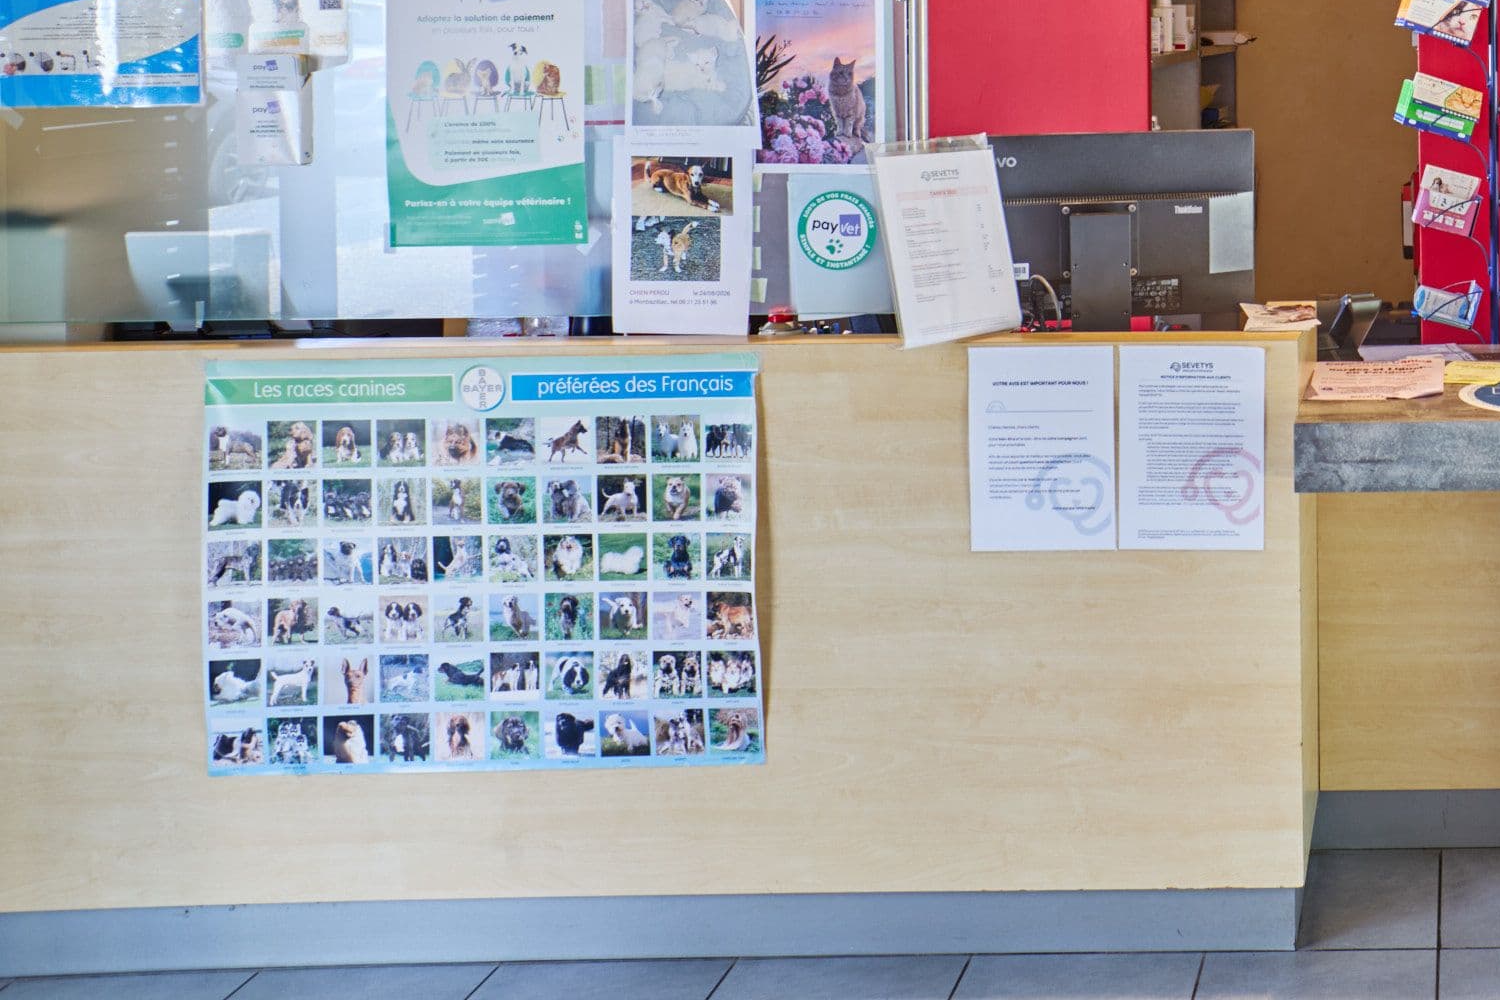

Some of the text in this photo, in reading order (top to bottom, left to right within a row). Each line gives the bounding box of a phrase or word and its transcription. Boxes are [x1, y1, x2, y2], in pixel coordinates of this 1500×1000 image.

[417, 14, 554, 24] Adoptez la solution de paiement
[516, 198, 566, 206] vétérinaire
[812, 220, 838, 234] pay
[254, 380, 406, 398] Les races canines
[463, 384, 503, 392] BAYER
[537, 375, 734, 398] préférées des Français
